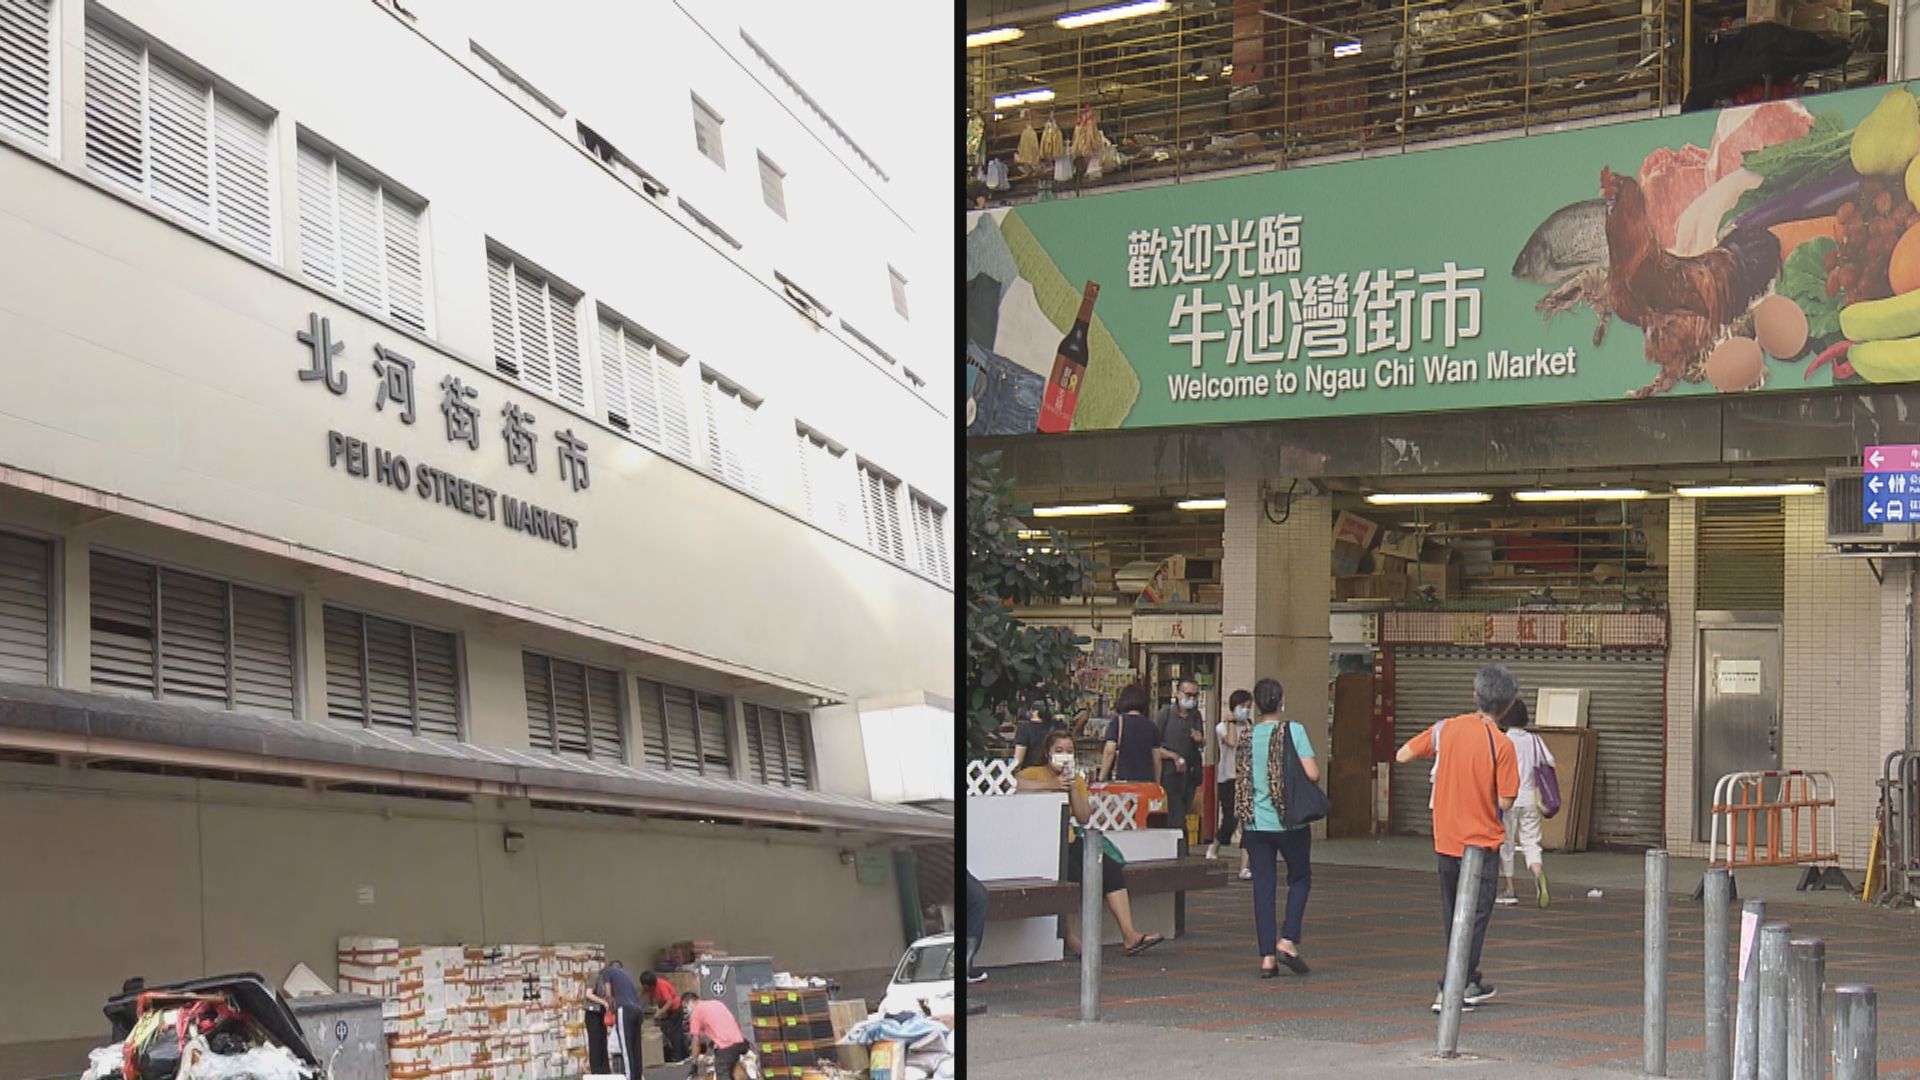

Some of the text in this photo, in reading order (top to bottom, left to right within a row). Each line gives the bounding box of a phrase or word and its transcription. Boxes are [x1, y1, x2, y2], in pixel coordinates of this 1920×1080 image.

[1128, 213, 1302, 287] 歡迎光臨
[1168, 262, 1485, 368] 牛池灣街市
[297, 312, 591, 492] 北河街街市
[1168, 346, 1576, 400] Welcome to Ngau Chi Wan Market
[328, 430, 579, 549] PEI HO STREET MARKET
